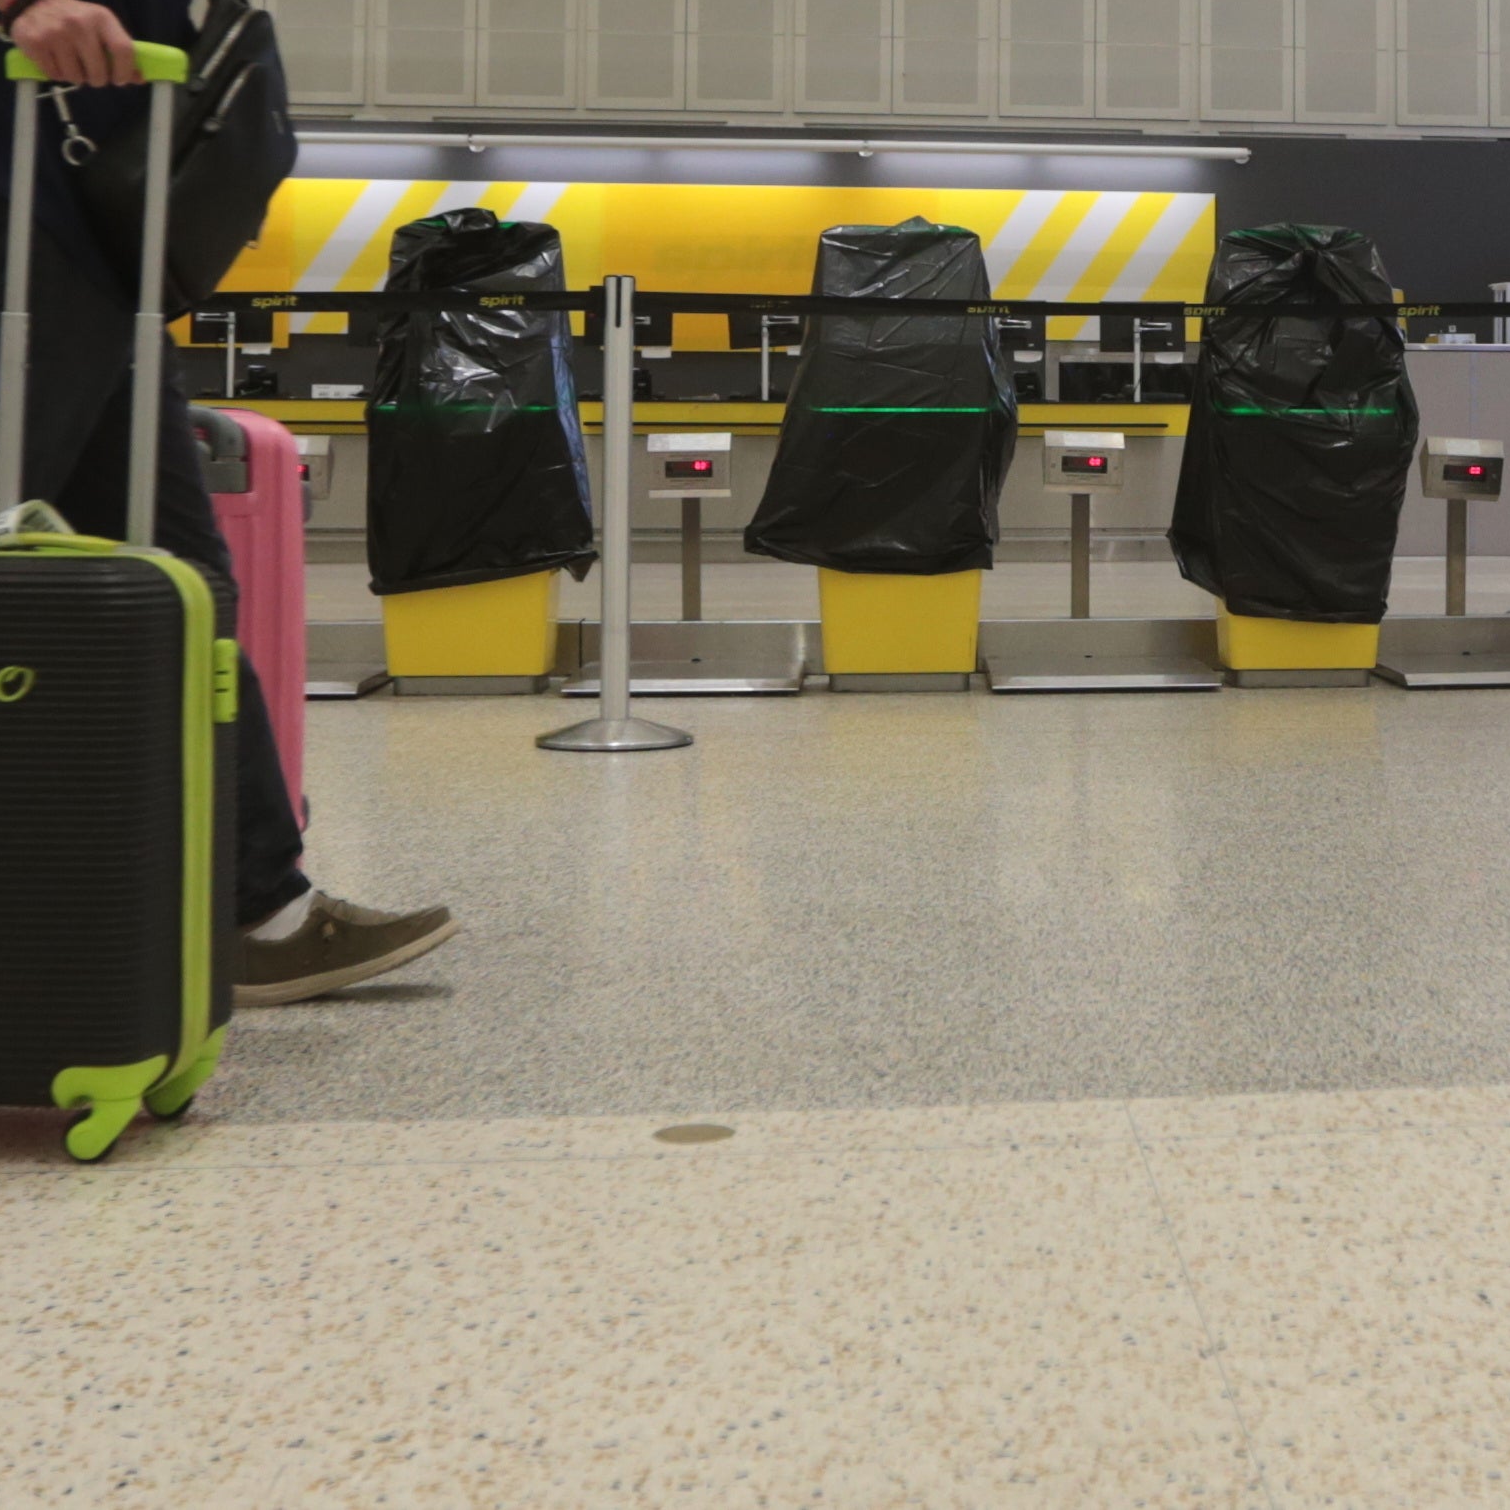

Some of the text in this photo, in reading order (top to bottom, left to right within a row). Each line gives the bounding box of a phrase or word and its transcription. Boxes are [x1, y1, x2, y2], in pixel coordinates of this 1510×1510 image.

[251, 295, 298, 309] spirit
[479, 295, 525, 308] spirit
[1397, 305, 1441, 317] spirit
